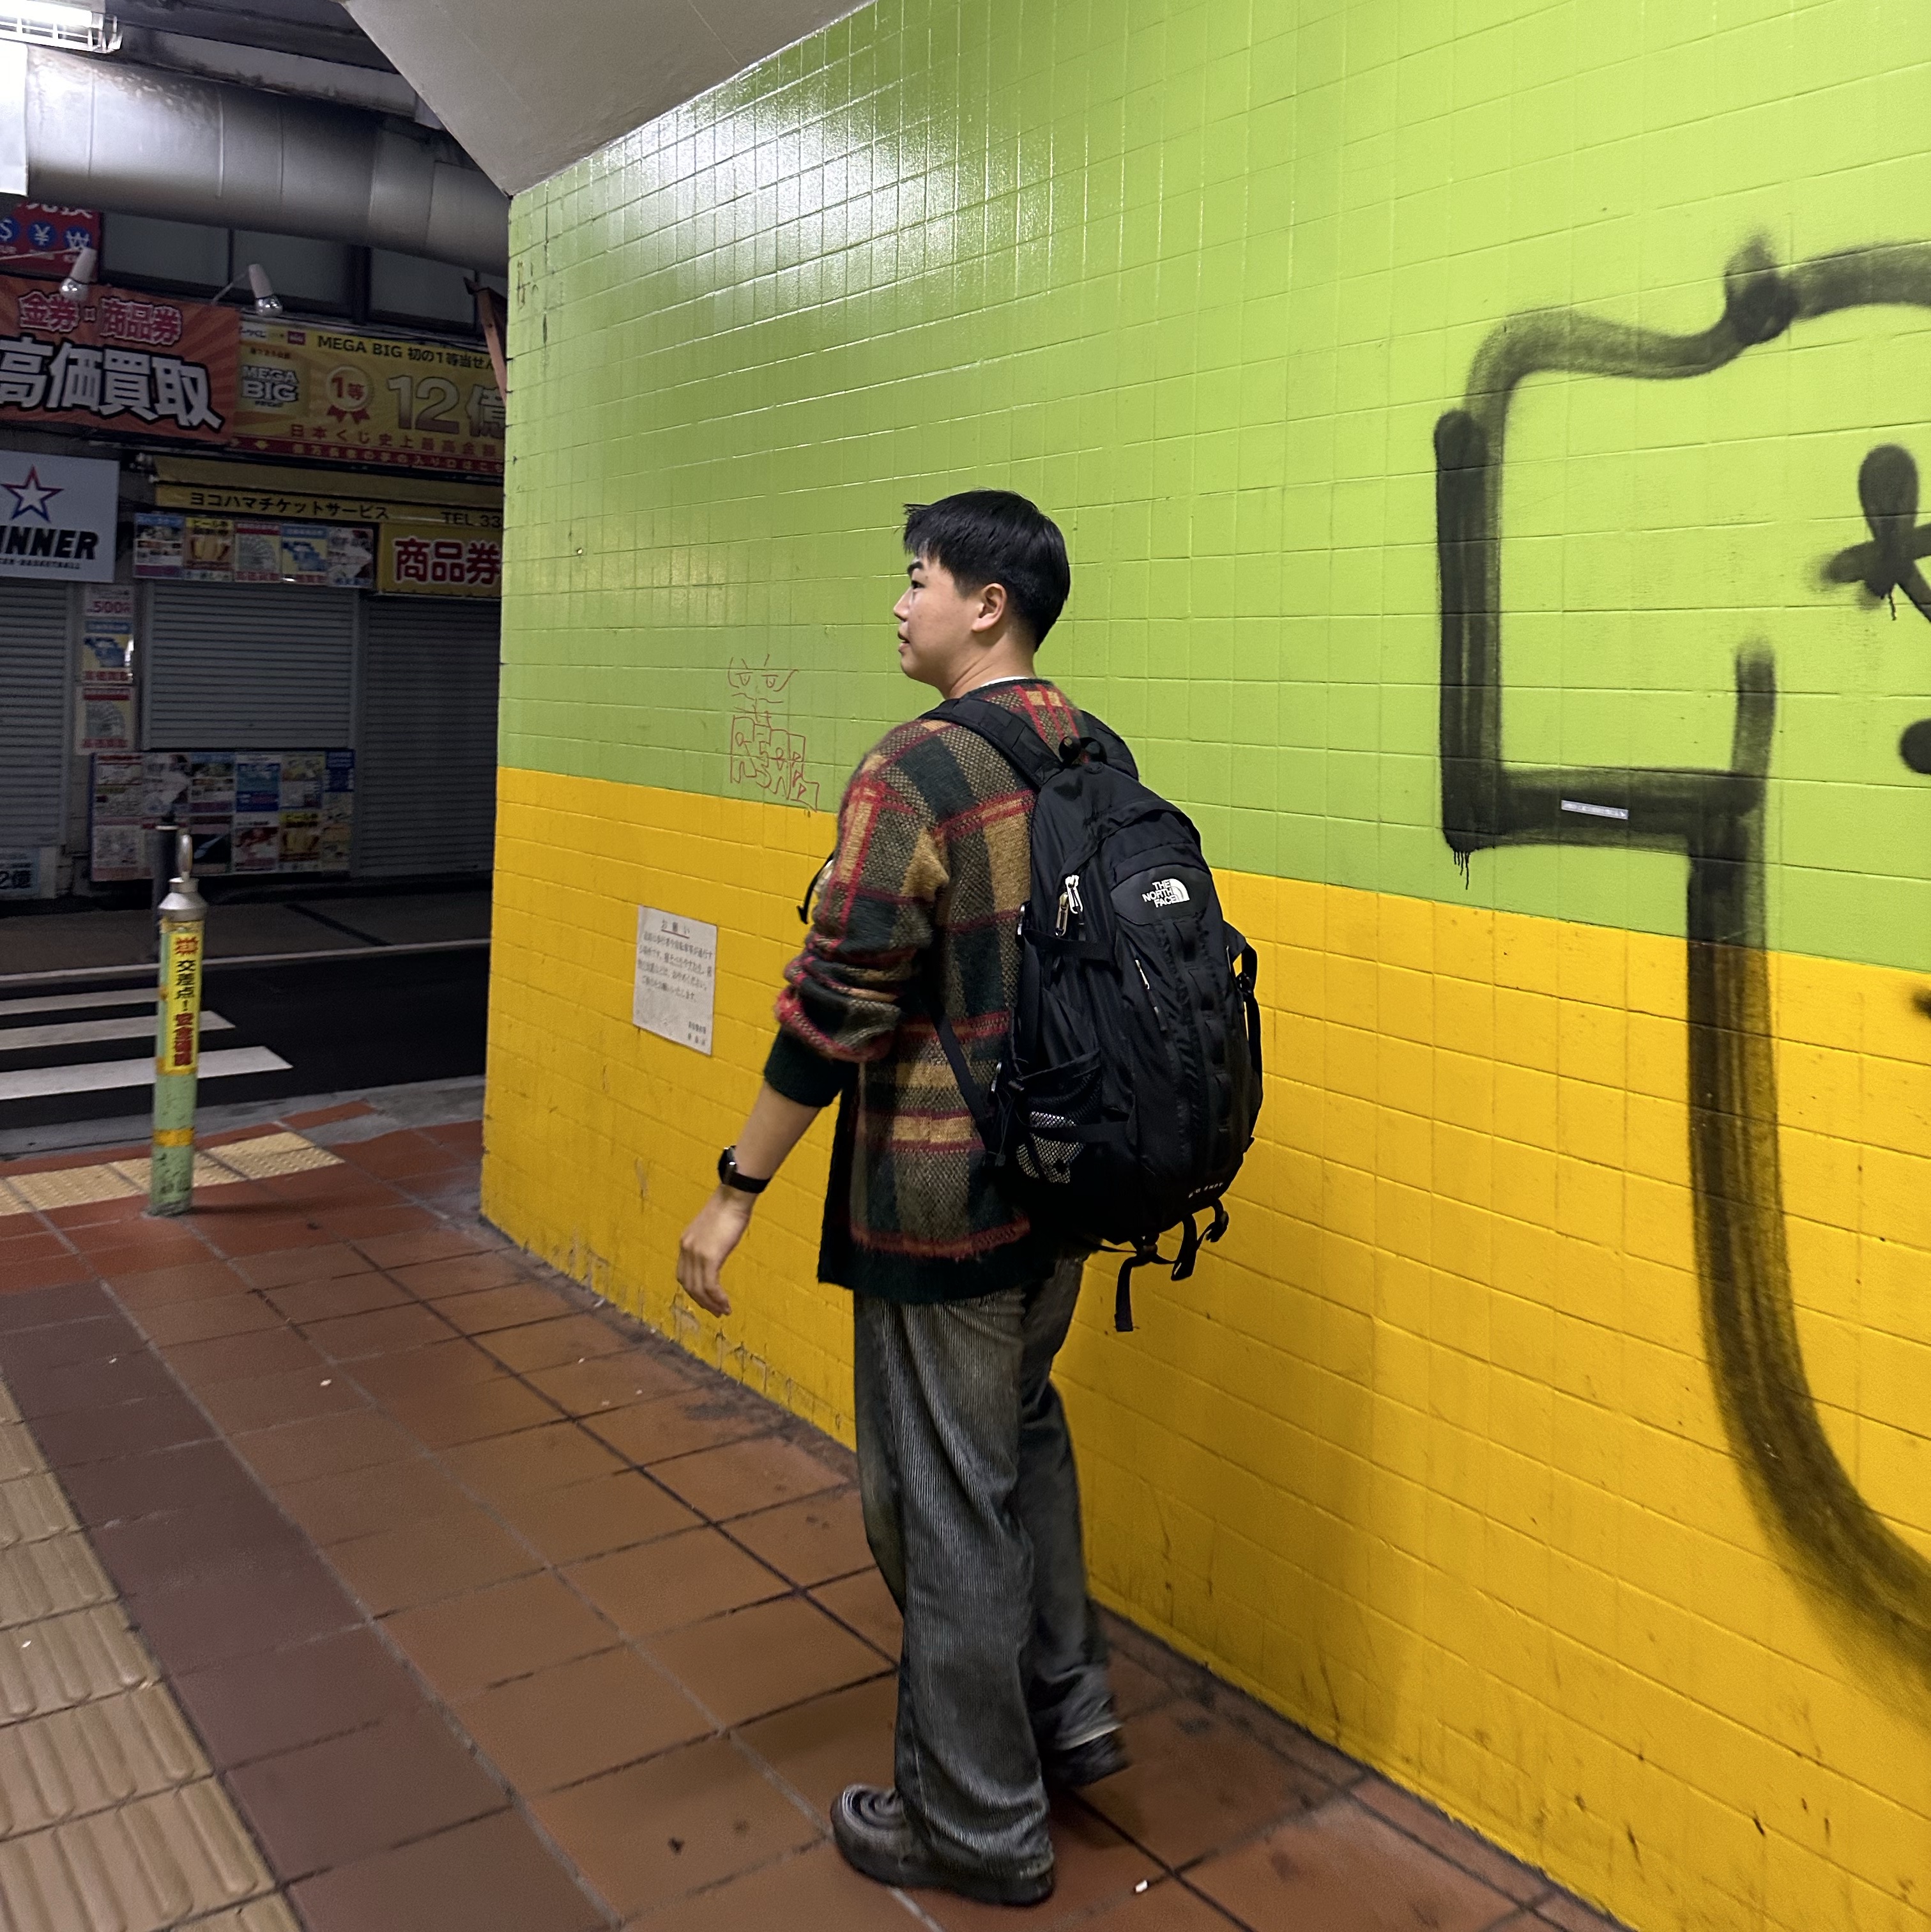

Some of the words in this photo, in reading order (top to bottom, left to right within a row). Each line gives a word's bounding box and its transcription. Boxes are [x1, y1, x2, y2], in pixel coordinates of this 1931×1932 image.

[318, 335, 367, 353] MEGA
[373, 343, 402, 358] BIG
[0, 335, 223, 430] 高価買取
[241, 365, 299, 384] MEGA
[242, 379, 298, 402] BIG
[191, 492, 389, 519] ヨコハマチケットサービス
[441, 512, 474, 526] TEL
[393, 537, 502, 586] 商品券
[1141, 887, 1173, 902] NORTH
[1152, 880, 1171, 891] THE
[1154, 895, 1177, 908] FACE
